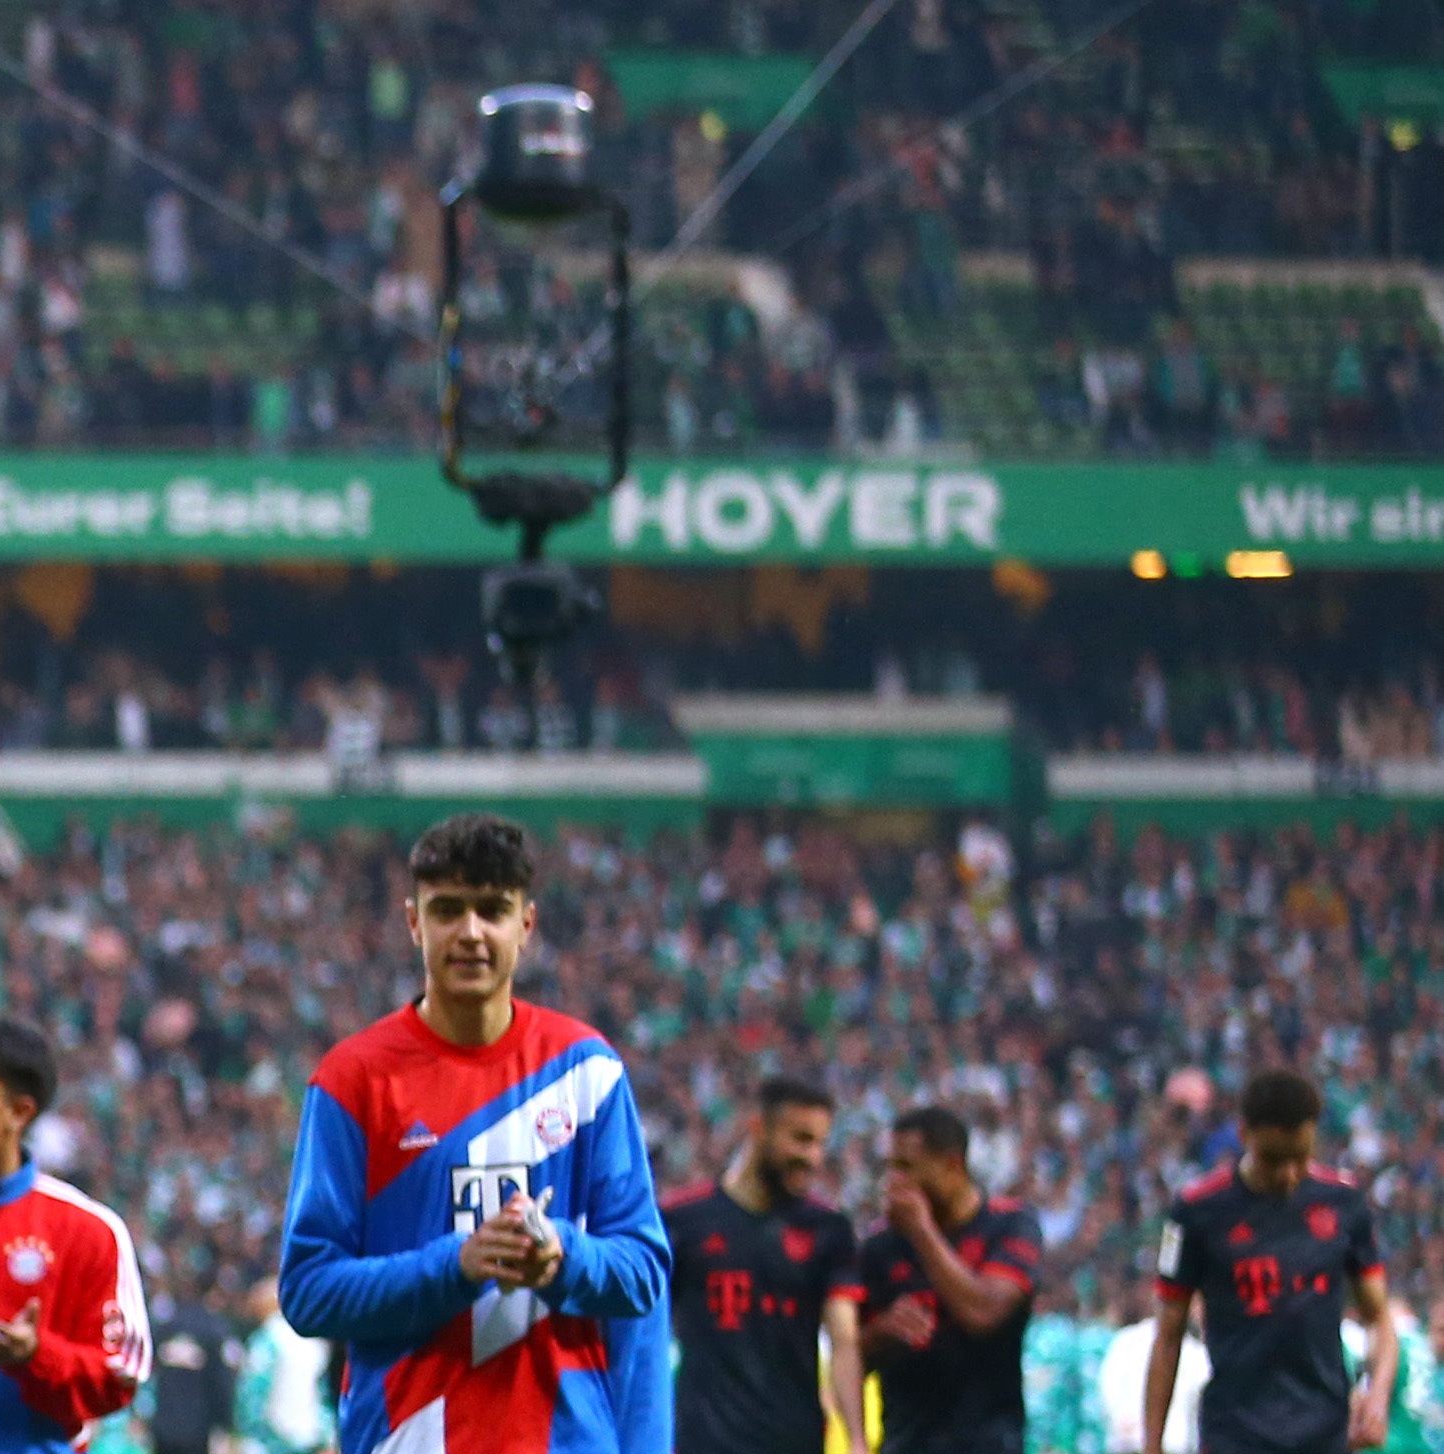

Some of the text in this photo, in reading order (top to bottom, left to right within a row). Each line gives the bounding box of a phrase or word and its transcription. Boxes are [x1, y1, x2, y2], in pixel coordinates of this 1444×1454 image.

[164, 477, 371, 538] Seite!
[611, 469, 1001, 552] HOYER
[1239, 483, 1359, 543] Wir
